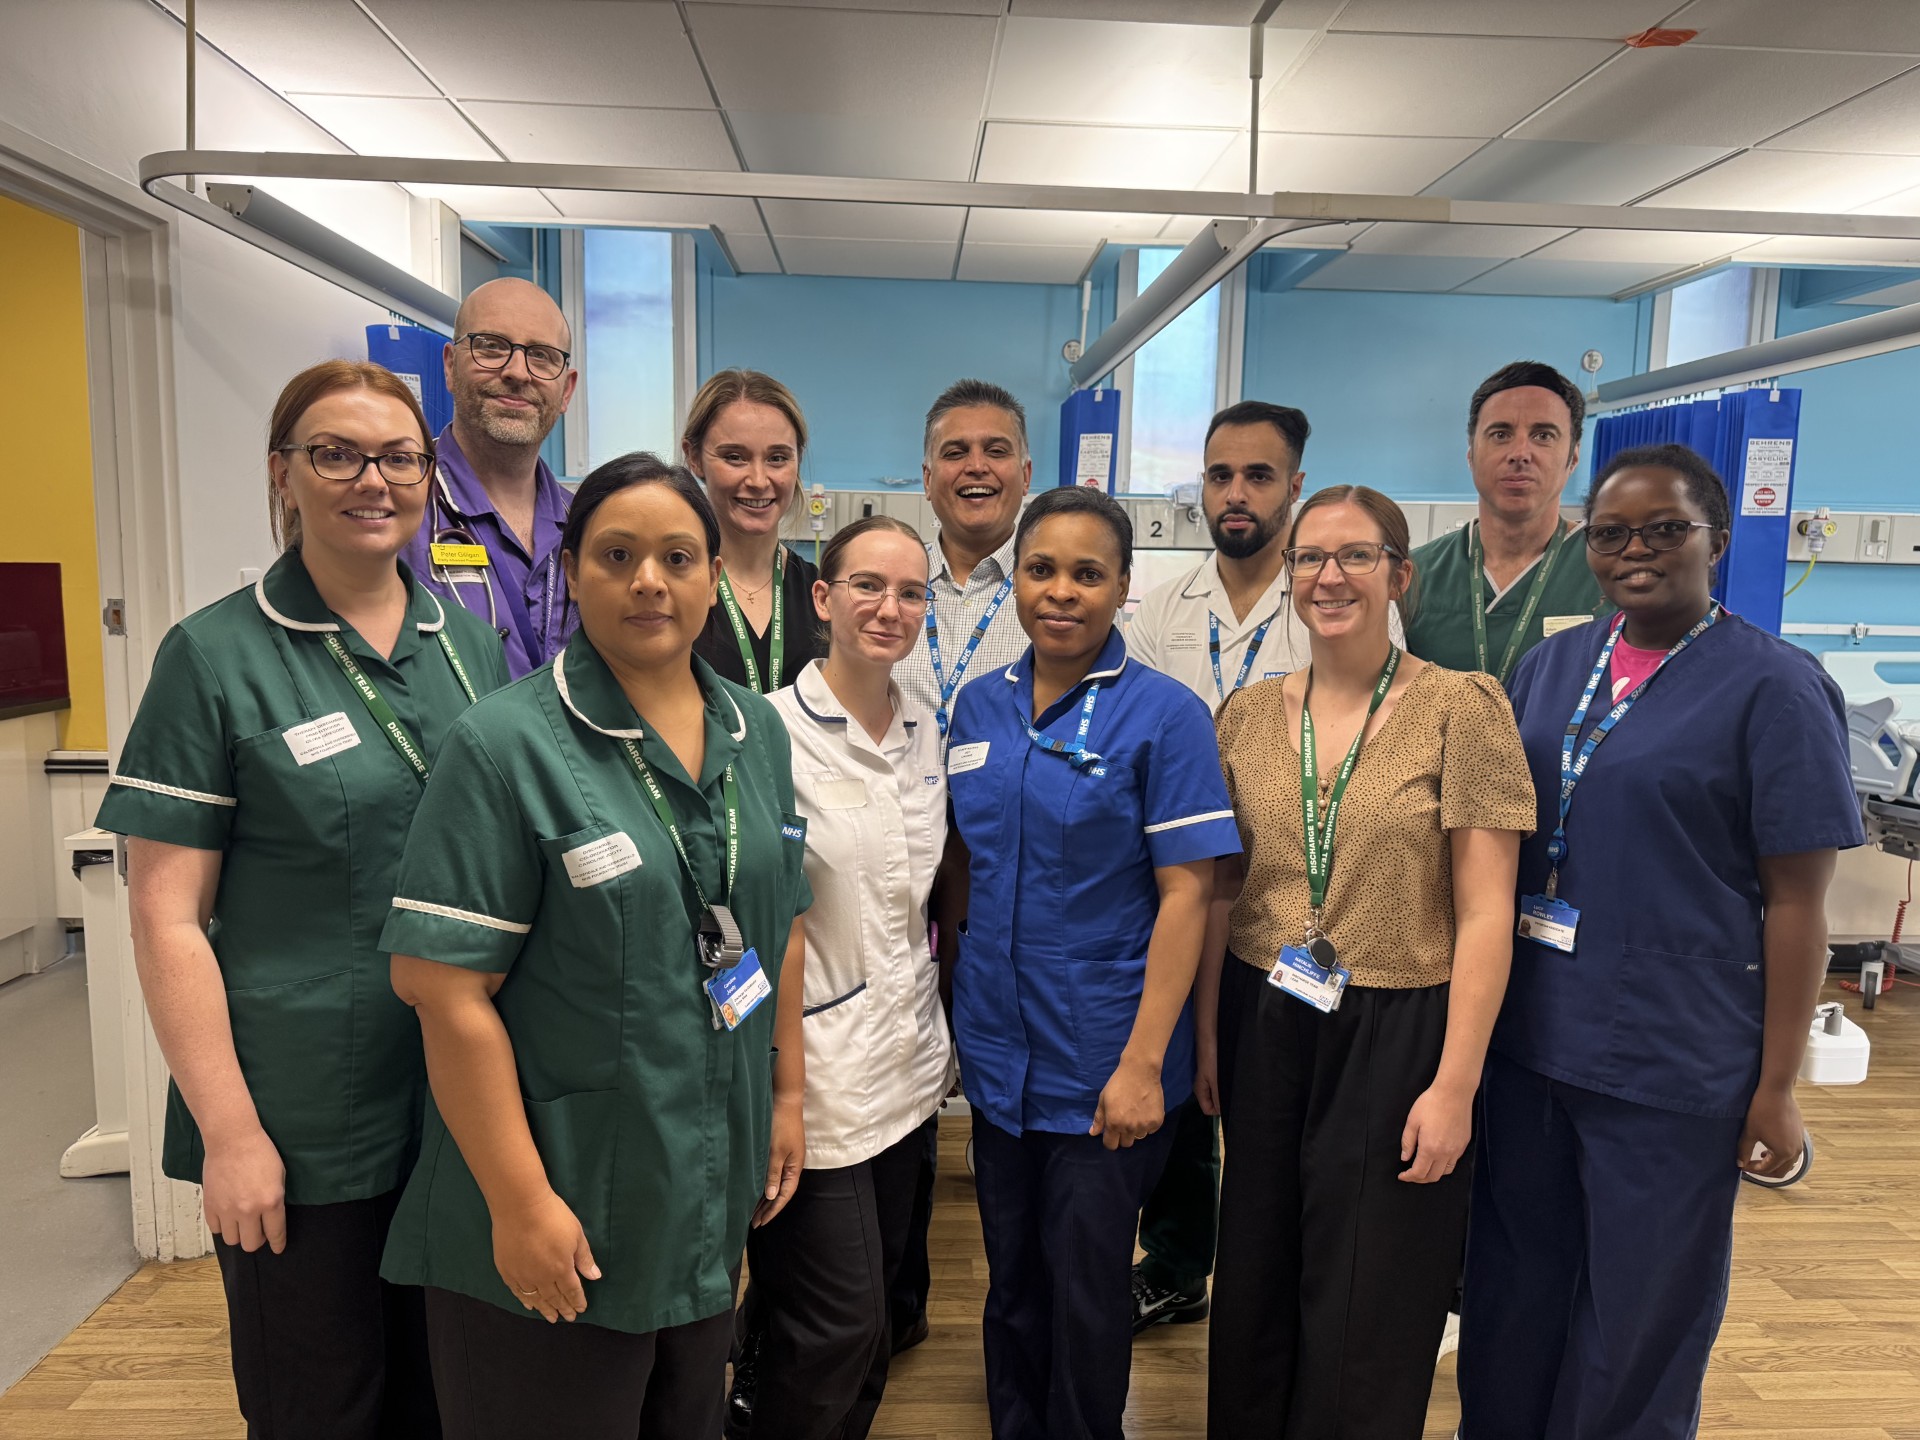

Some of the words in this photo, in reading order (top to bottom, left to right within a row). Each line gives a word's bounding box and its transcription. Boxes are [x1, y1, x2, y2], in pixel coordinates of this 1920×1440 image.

[1150, 521, 1162, 537] 2
[719, 580, 731, 599] TEAM
[997, 584, 1009, 600] NHS
[985, 602, 998, 618] NHS
[726, 601, 746, 640] DISCHARGE
[1689, 620, 1709, 639] NHS
[440, 634, 455, 657] TEAM
[1607, 630, 1619, 646] NHS
[932, 648, 940, 664] NHS
[960, 648, 972, 666] NHS
[1669, 640, 1688, 656] NHS
[323, 632, 358, 674] SCHARGE
[355, 674, 376, 700] TEAM
[1387, 648, 1398, 674] HARGE
[1597, 651, 1610, 668] NHS
[746, 658, 756, 680] TEAM
[950, 668, 961, 686] NHS
[1238, 664, 1248, 681] NHS
[1378, 674, 1390, 694] TEAM
[1588, 673, 1600, 690] NHS
[1631, 681, 1647, 701] NHS
[1084, 695, 1095, 713] NHS
[1578, 694, 1591, 711] NHS
[1610, 701, 1628, 720] NHS
[1028, 728, 1040, 740] NHS
[1079, 718, 1089, 736] NHS
[387, 722, 425, 773] DISCHARGE
[624, 738, 646, 770] HARGE
[643, 772, 662, 800] TEAM
[1341, 756, 1353, 779] TEAM
[1562, 751, 1571, 772] NHS
[1573, 754, 1588, 776] NHS
[925, 775, 939, 785] NHS
[1088, 767, 1106, 776] NHS
[1562, 779, 1576, 800] NHS
[782, 826, 802, 838] NHS
[1324, 802, 1338, 850] DISCHARGE
[1308, 825, 1318, 874] DISCHARGE
[1532, 910, 1554, 920] ROWLEY
